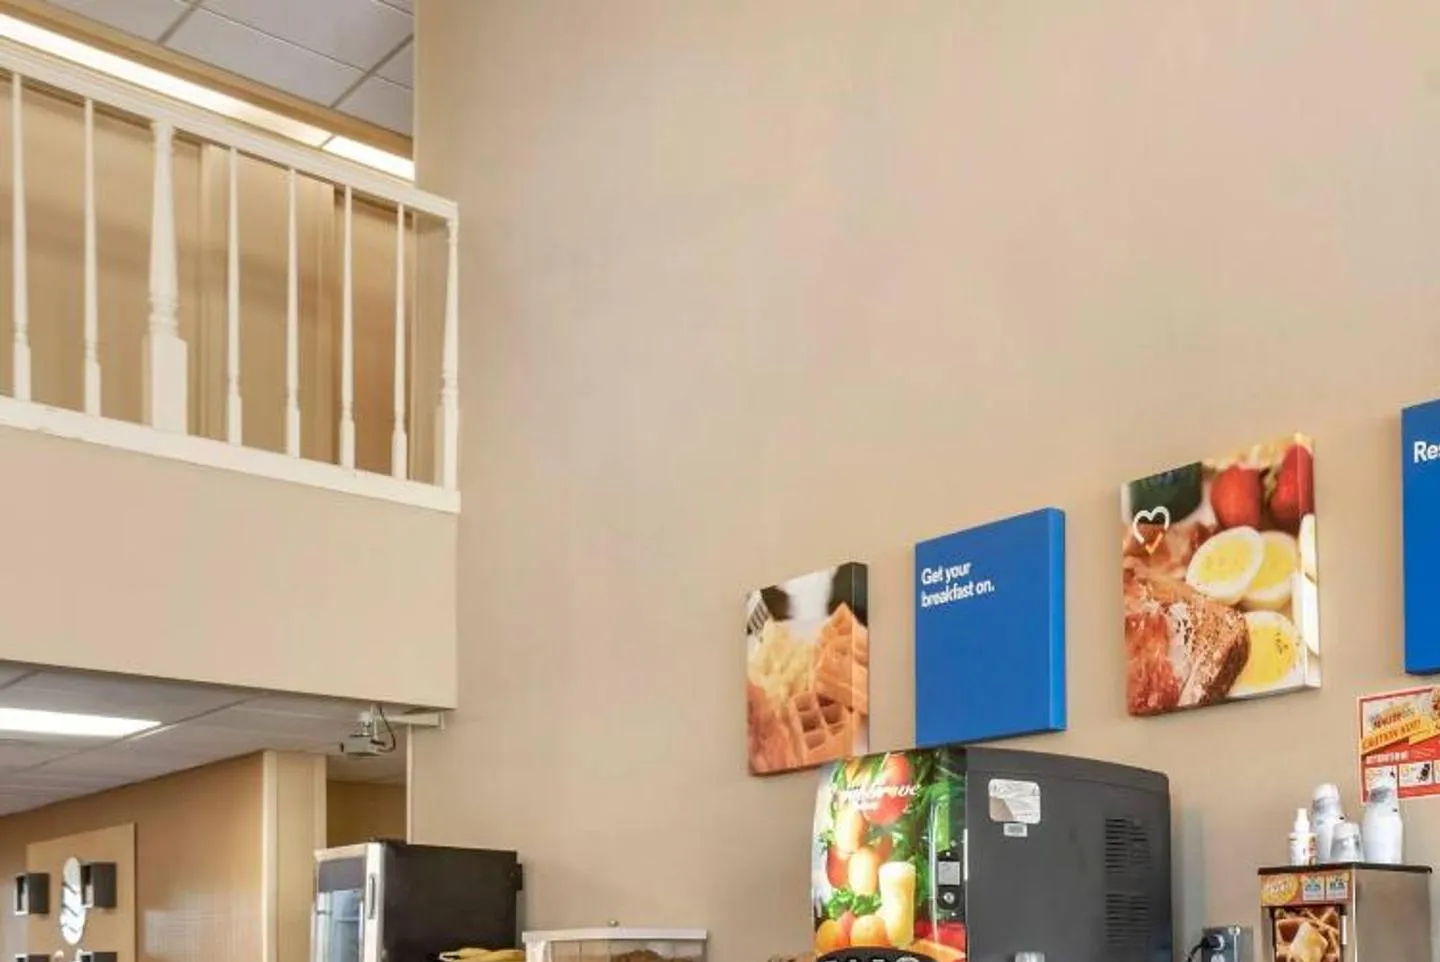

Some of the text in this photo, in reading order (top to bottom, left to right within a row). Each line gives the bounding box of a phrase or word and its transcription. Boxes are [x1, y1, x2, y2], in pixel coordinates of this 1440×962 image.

[921, 562, 971, 585] Get your
[921, 580, 995, 608] breakfast on.
